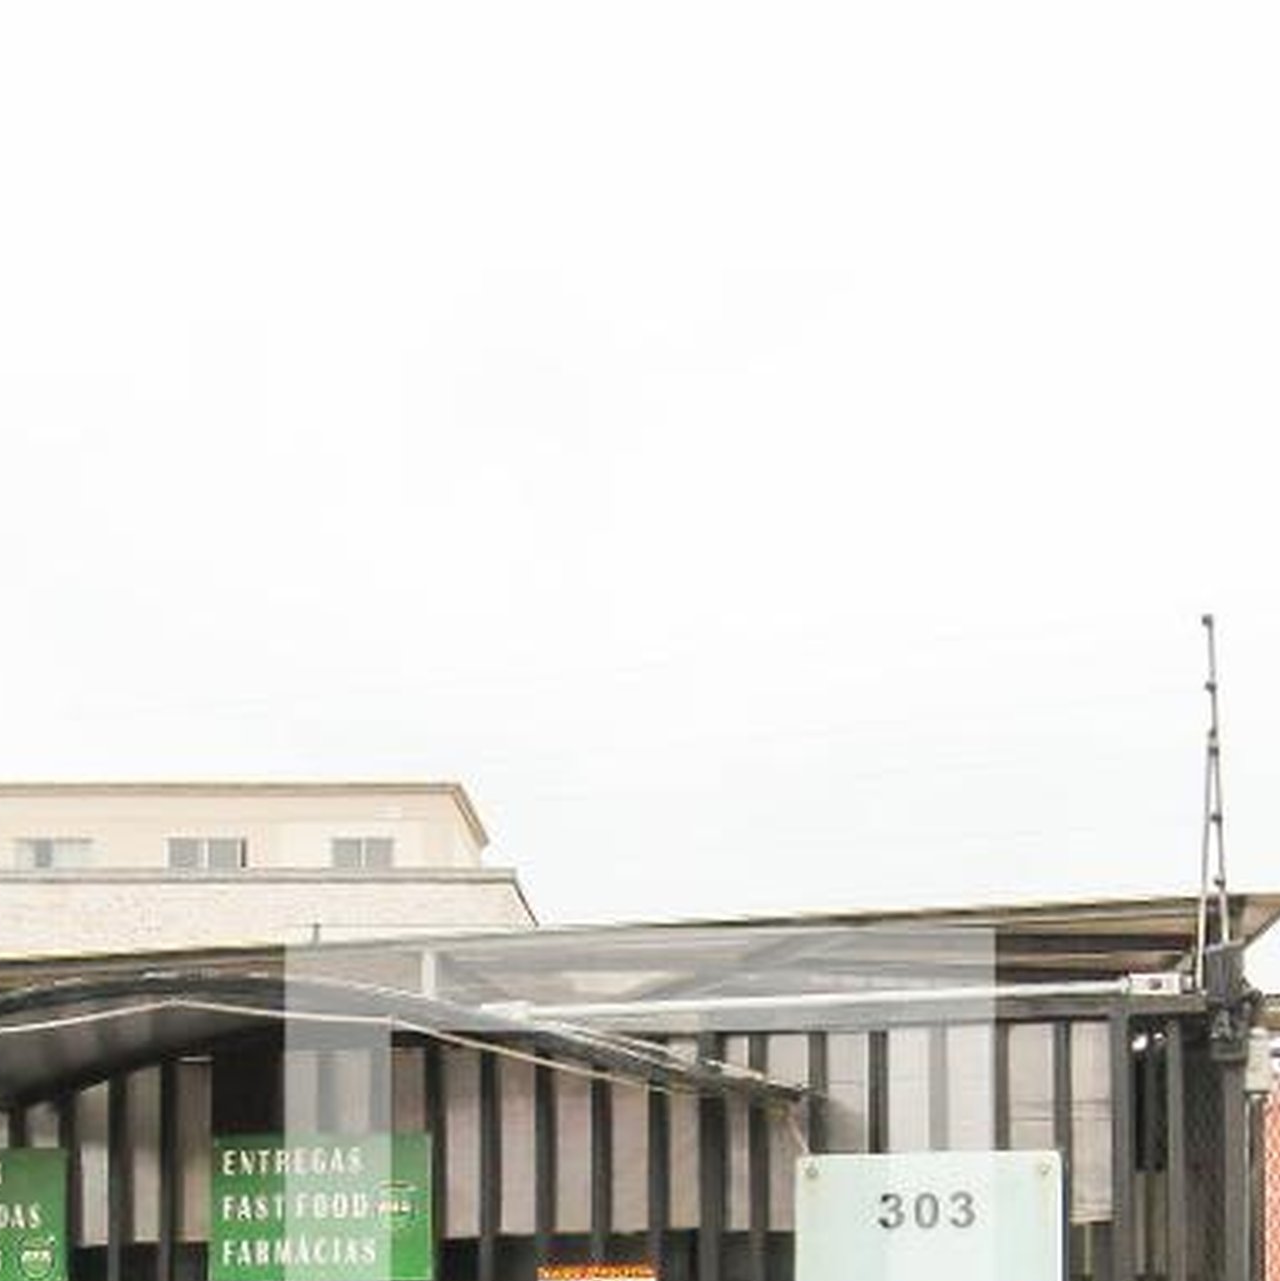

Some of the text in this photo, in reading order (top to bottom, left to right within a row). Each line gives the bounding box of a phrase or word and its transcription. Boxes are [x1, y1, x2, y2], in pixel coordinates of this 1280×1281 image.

[223, 1147, 363, 1175] ENTREGAS
[223, 1194, 284, 1220] FAST
[295, 1192, 368, 1219] FOOD
[878, 1191, 976, 1229] 303
